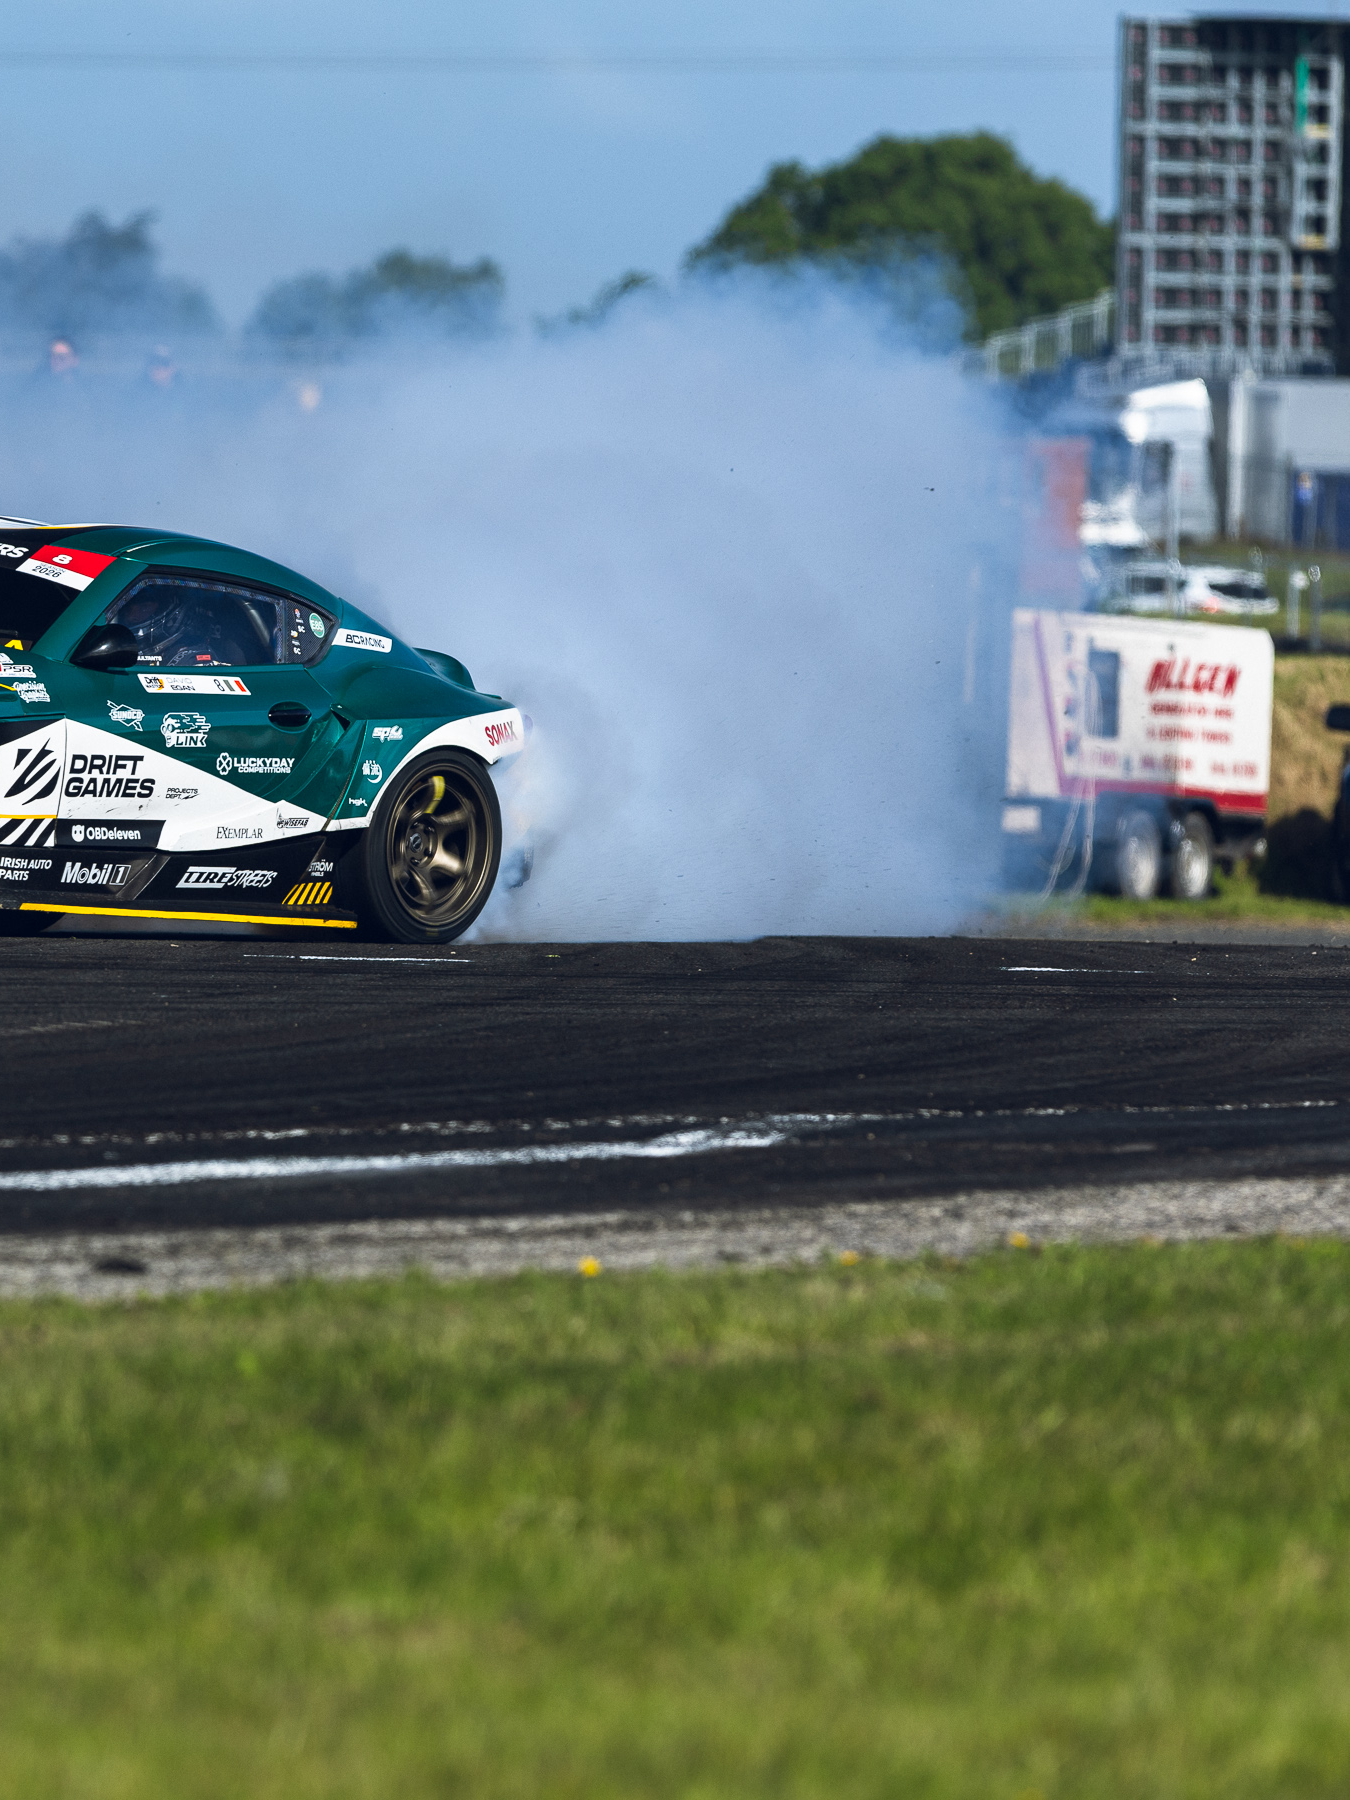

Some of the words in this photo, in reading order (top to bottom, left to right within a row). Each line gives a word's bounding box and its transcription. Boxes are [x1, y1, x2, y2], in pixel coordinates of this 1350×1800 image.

[52, 554, 73, 565] 8
[31, 565, 62, 578] 2026
[3, 665, 32, 673] PSR
[213, 679, 225, 692] 8
[112, 709, 142, 720] SUNOCO
[484, 720, 518, 746] SONAX
[175, 735, 208, 747] LINK
[69, 754, 144, 775] DRIFT
[233, 757, 295, 768] LUCKYDAY
[237, 766, 291, 774] COMPETITIONS
[64, 777, 156, 798] GAMES
[86, 826, 141, 840] OBDeleven
[216, 826, 263, 839] EXEMPLAR
[0, 857, 28, 868] IRISH
[28, 859, 52, 870] AUTO
[309, 859, 334, 872] STRÖM
[60, 862, 113, 885] Mobil
